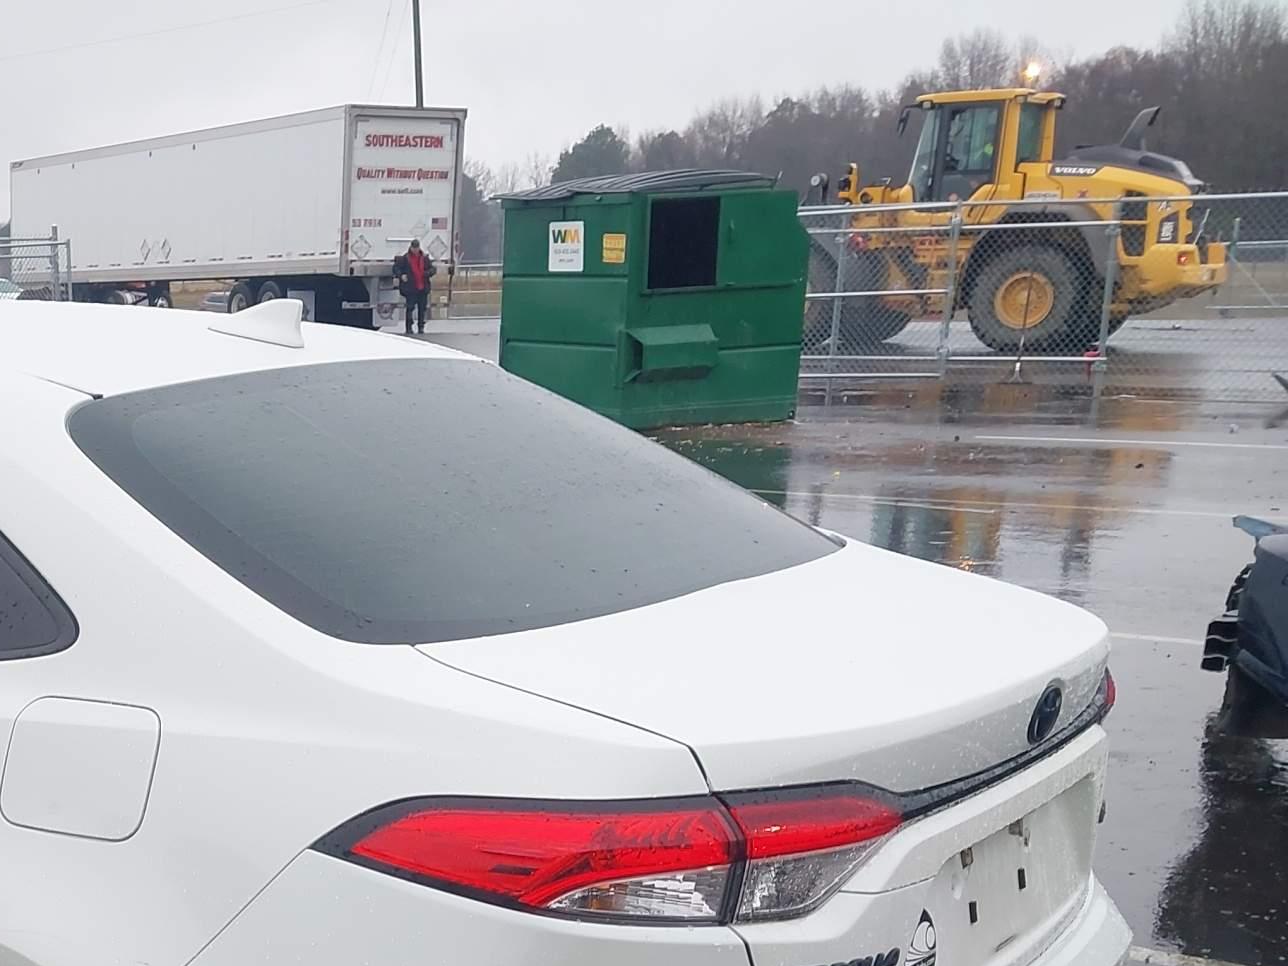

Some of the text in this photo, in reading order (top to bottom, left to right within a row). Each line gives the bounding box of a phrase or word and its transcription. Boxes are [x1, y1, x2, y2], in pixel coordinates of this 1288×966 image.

[365, 134, 444, 148] SOUTHEASTERN
[357, 167, 386, 180] QUALITY
[386, 168, 416, 179] WITHOUT
[1055, 166, 1097, 175] VOLVO
[552, 229, 581, 244] WM
